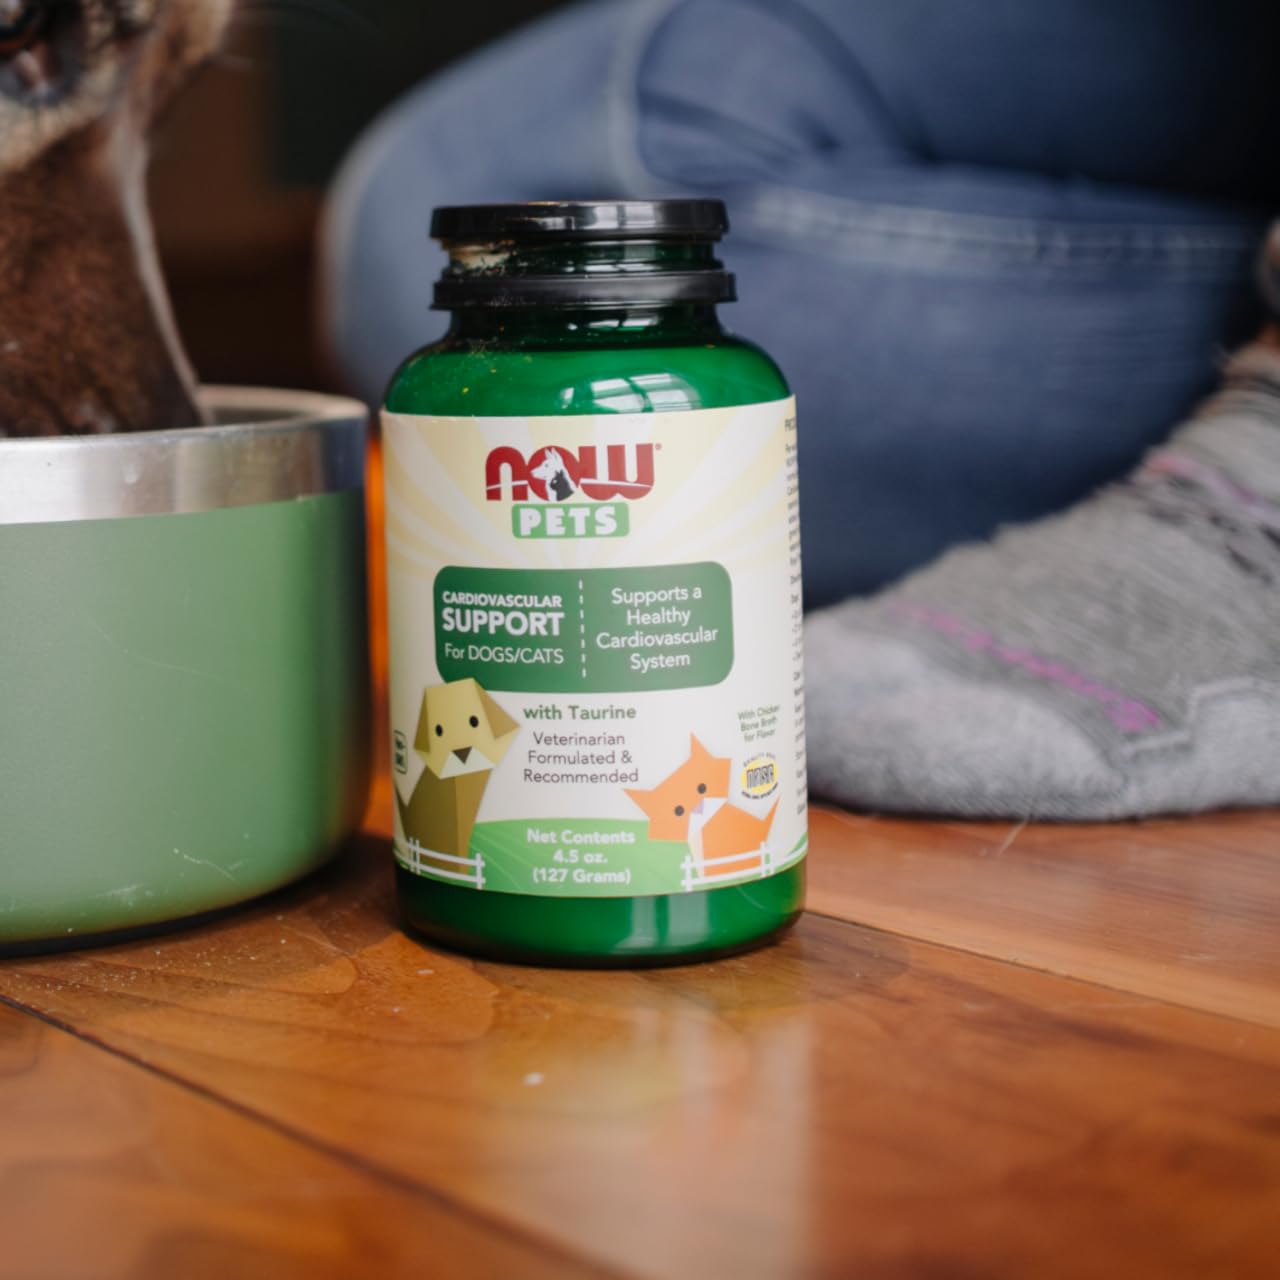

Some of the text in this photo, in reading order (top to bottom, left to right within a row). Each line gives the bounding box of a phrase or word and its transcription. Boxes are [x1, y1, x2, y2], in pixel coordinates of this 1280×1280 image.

[519, 506, 617, 536] PETS
[442, 591, 562, 608] CARDIOVASCULAR
[611, 586, 702, 607] Supports a
[442, 609, 565, 636] SUPPORT
[627, 608, 692, 628] Healthy
[596, 627, 719, 649] Cardiovascular
[444, 643, 565, 665] For DOGS/CATS
[629, 653, 691, 674] System
[523, 704, 637, 720] with Taurine
[738, 711, 755, 721] With
[533, 731, 626, 746] Veterinarian
[527, 750, 633, 765] Formulated &
[523, 769, 639, 784] Recommended
[526, 828, 635, 845] Net Contents
[553, 849, 608, 864] 4.5 oz.
[533, 868, 632, 885] (127 Grams)
